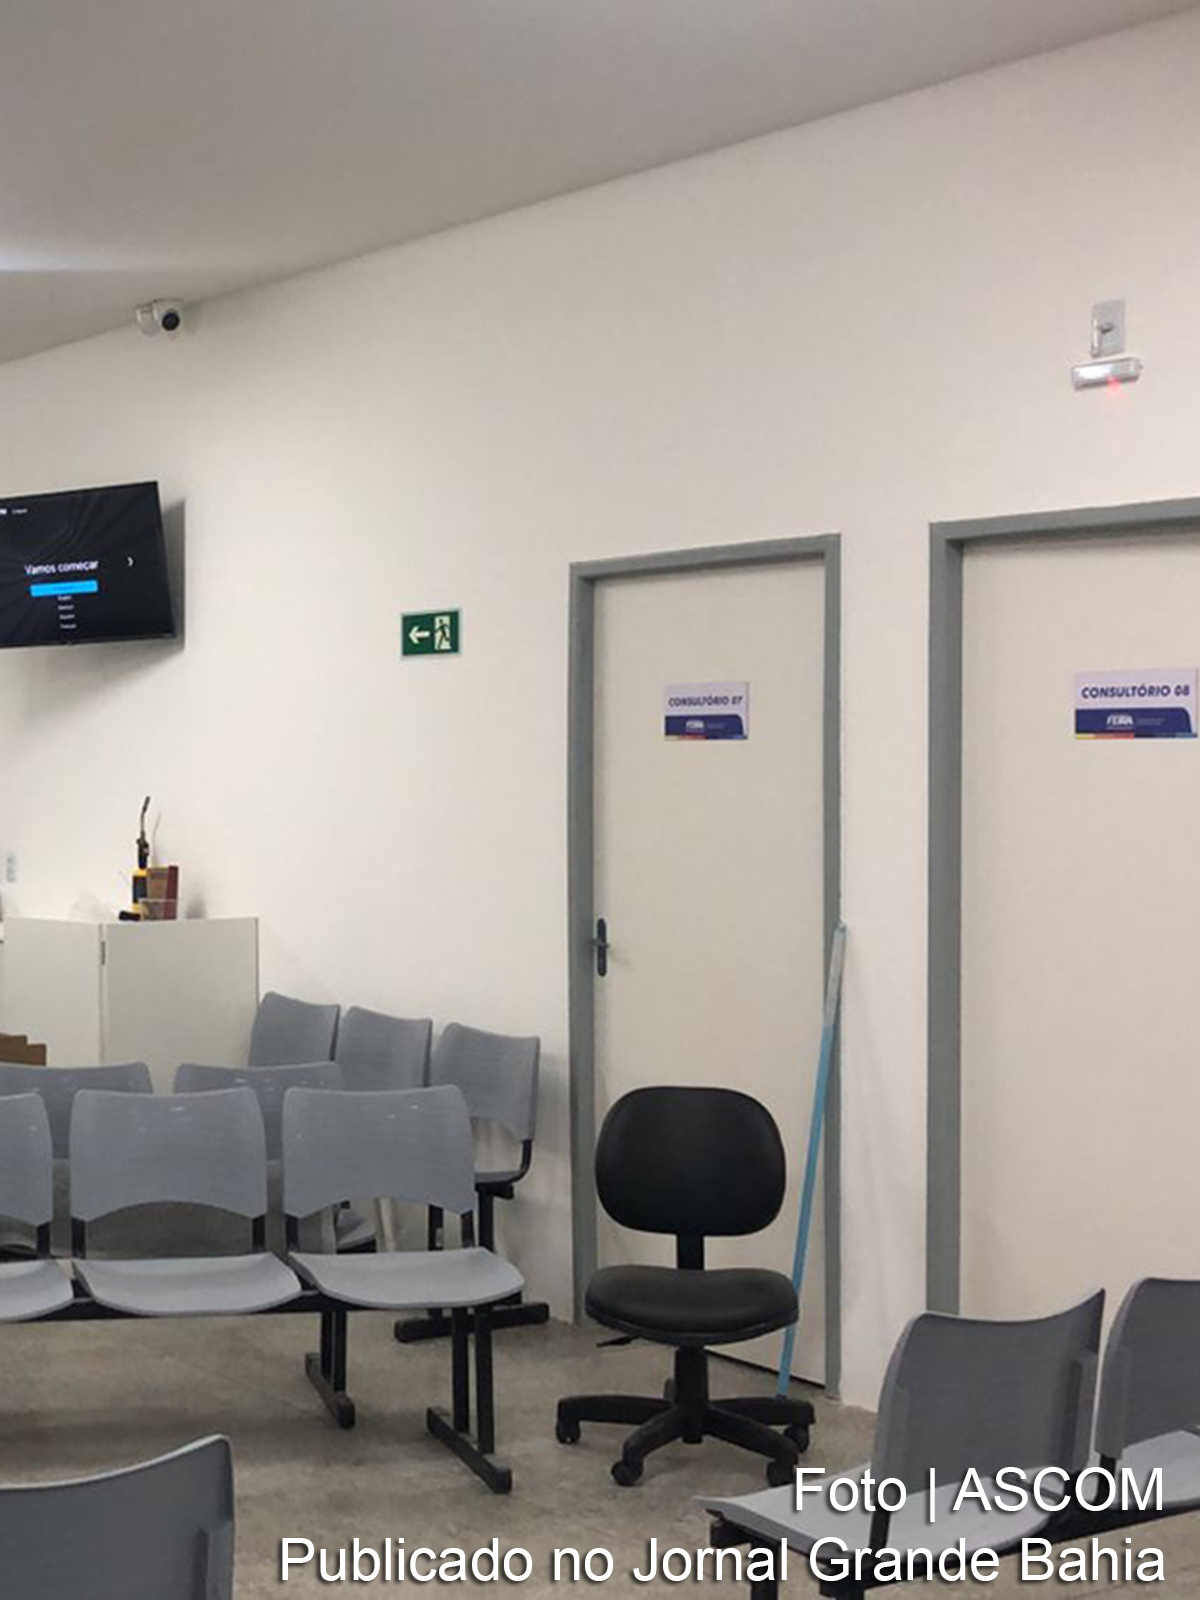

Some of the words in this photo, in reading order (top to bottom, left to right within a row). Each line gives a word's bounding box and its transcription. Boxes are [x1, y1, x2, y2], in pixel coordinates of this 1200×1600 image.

[24, 564, 56, 575] Vamos
[57, 560, 99, 573] começar
[1081, 683, 1171, 699] CONSULTÓRIO
[668, 695, 730, 707] CONSULTÓRIO
